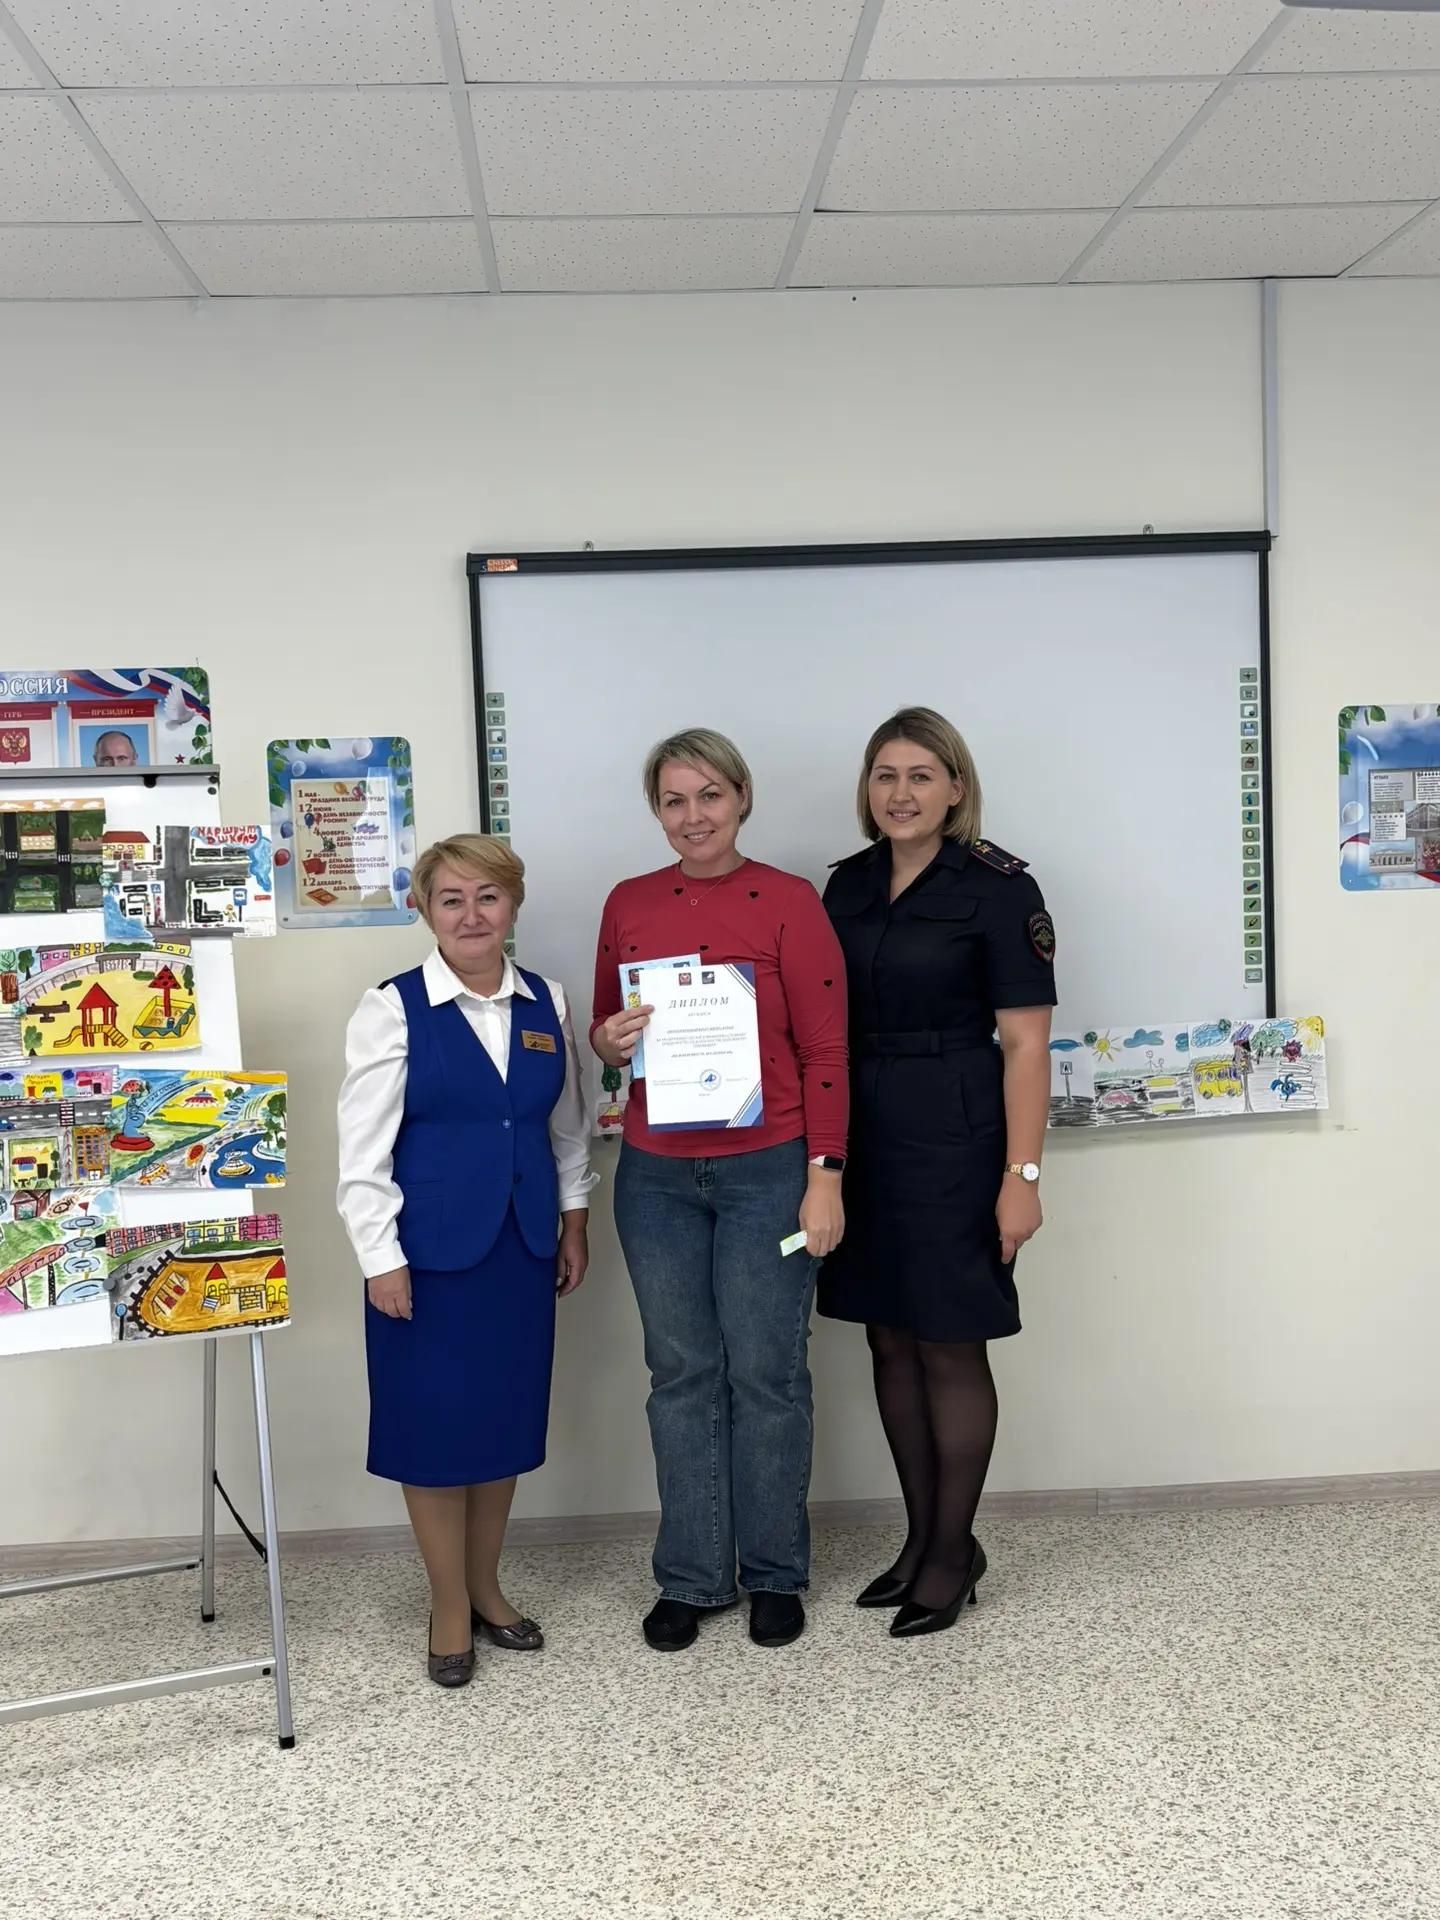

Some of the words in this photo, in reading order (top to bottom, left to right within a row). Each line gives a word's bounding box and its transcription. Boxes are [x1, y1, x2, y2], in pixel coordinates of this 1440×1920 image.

[91, 708, 134, 716] ПРЕЗИДЕНТ
[298, 790, 303, 798] 1
[299, 804, 312, 812] 12
[313, 827, 320, 836] 4
[306, 850, 312, 858] 7
[303, 878, 316, 886] 12
[668, 996, 729, 1009] ДИПЛОМ
